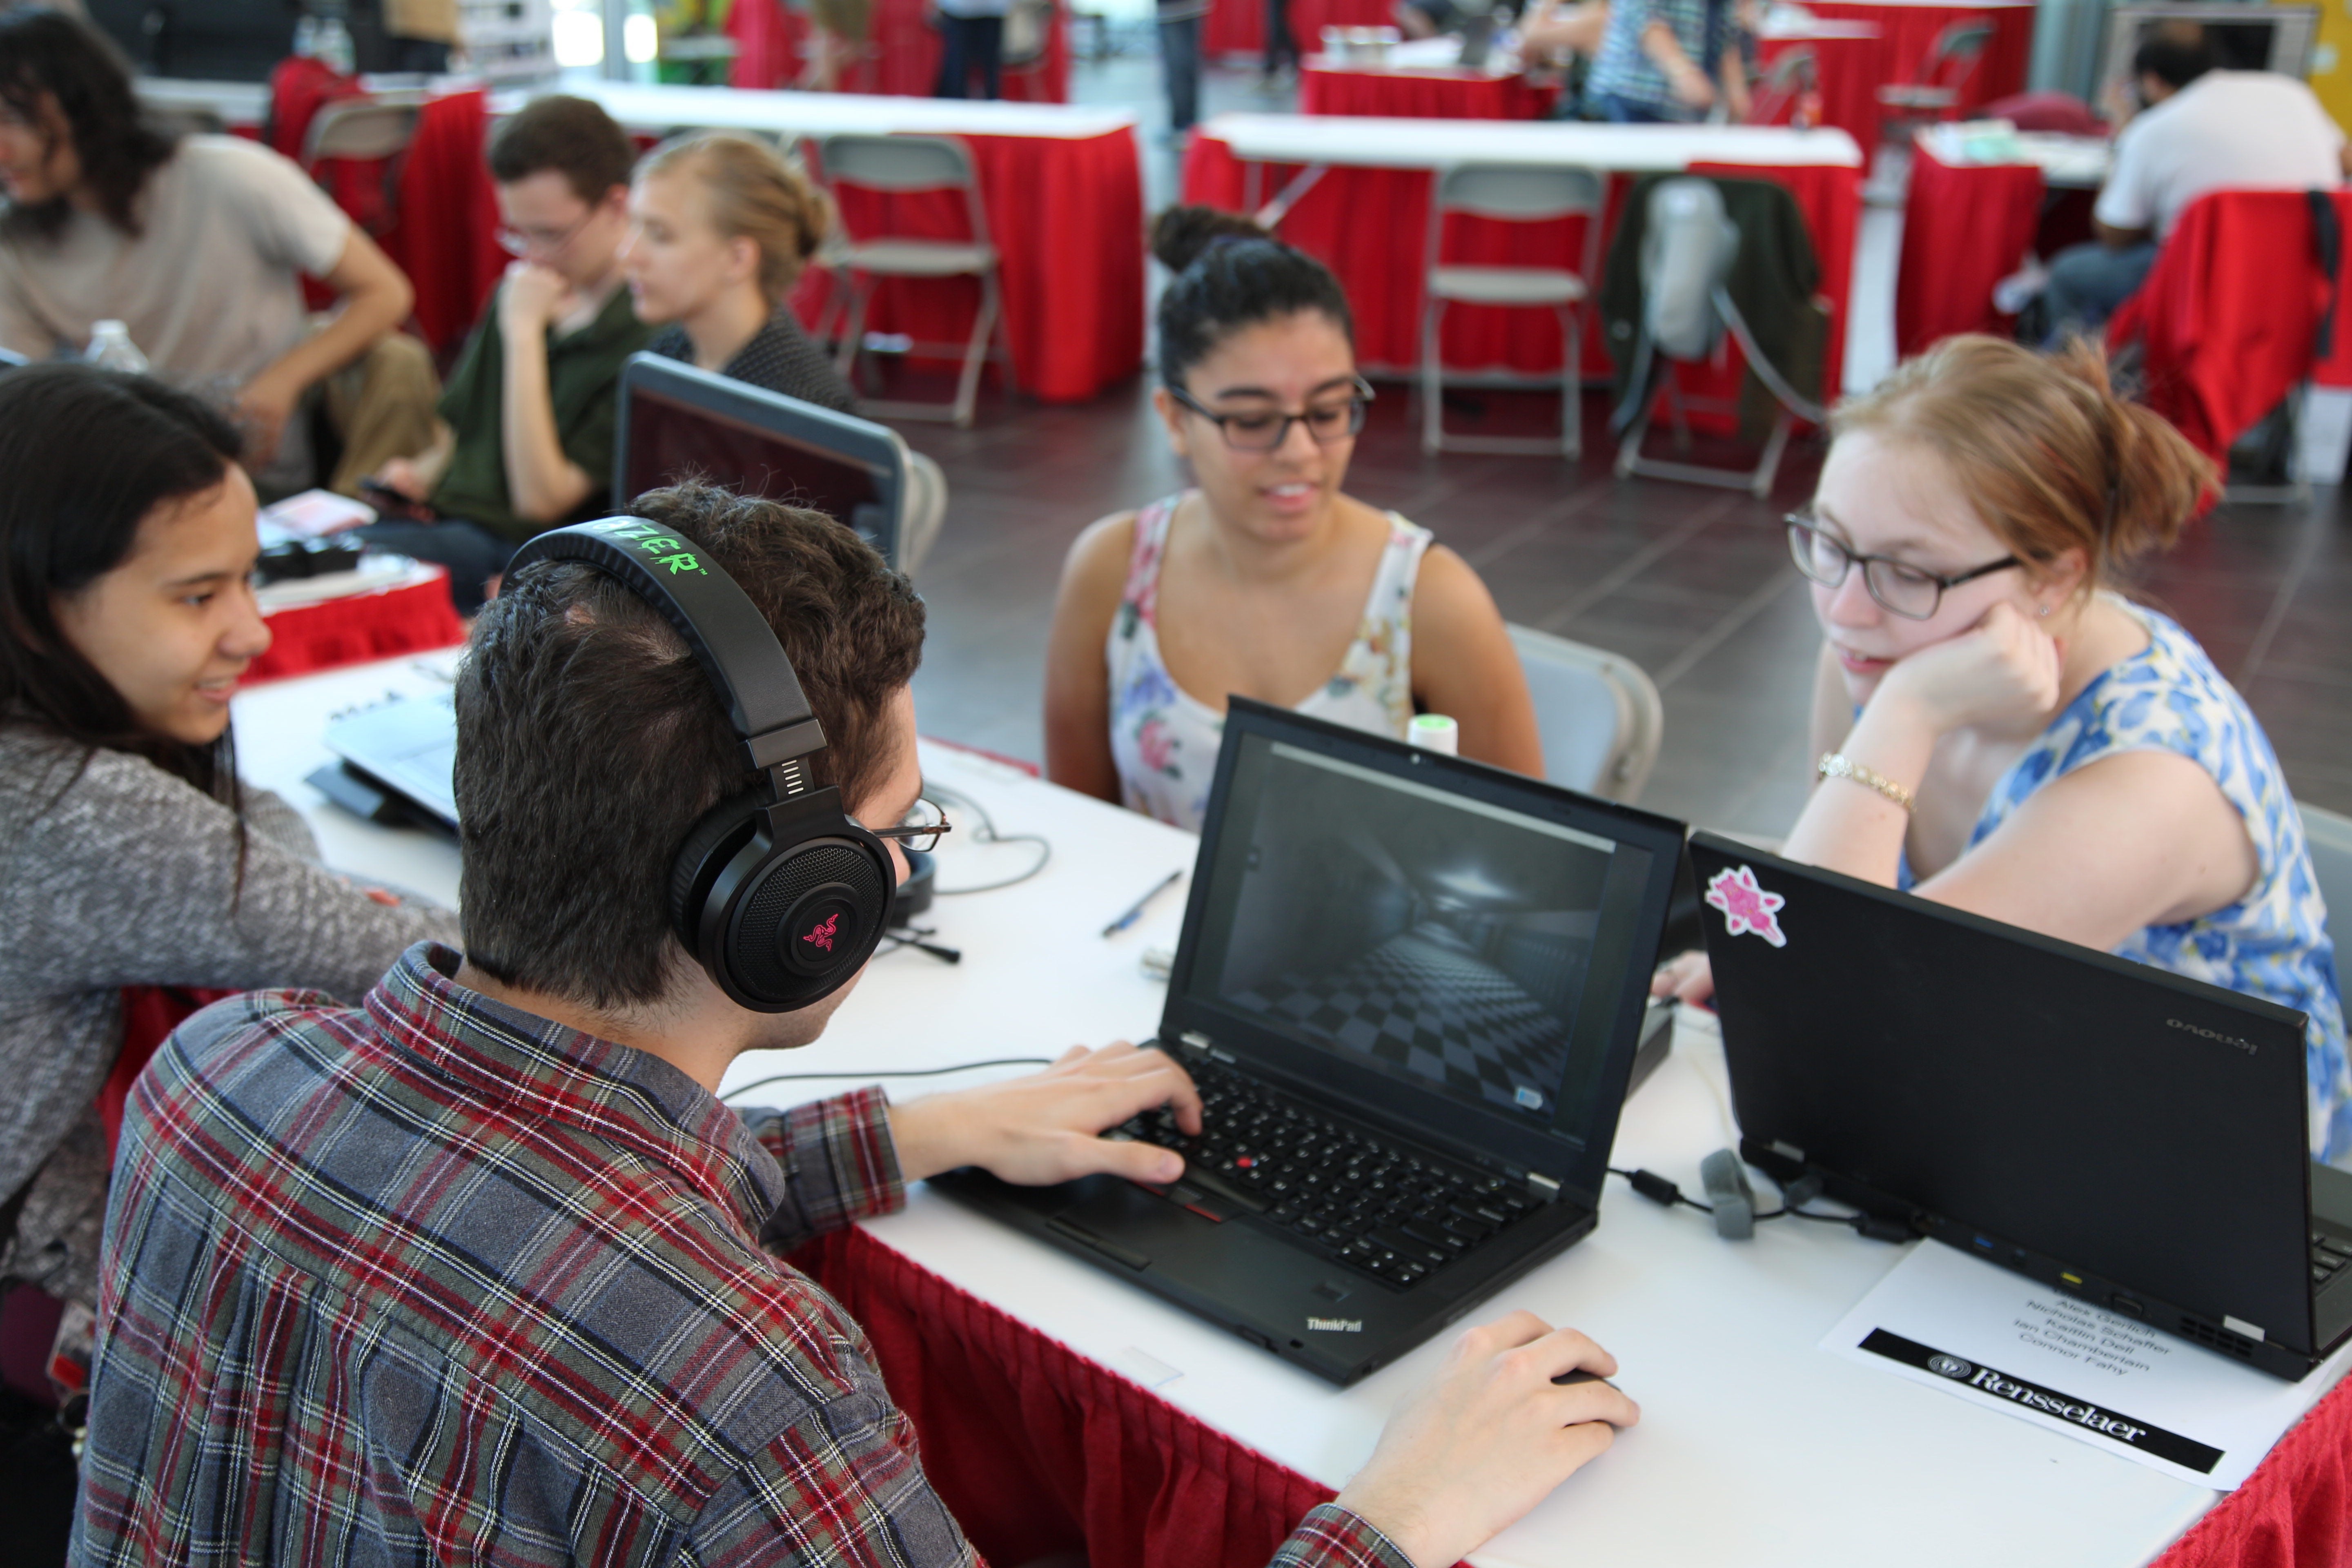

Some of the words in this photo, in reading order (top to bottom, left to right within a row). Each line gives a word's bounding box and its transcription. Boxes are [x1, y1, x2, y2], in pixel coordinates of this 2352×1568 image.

[2166, 1018, 2258, 1056] lenovo
[1306, 1316, 1363, 1332] ThinkPad
[2026, 1299, 2096, 1330] Nicholas
[2043, 1328, 2151, 1372] Chamberlain
[1969, 1367, 2147, 1442] Rensselaer
